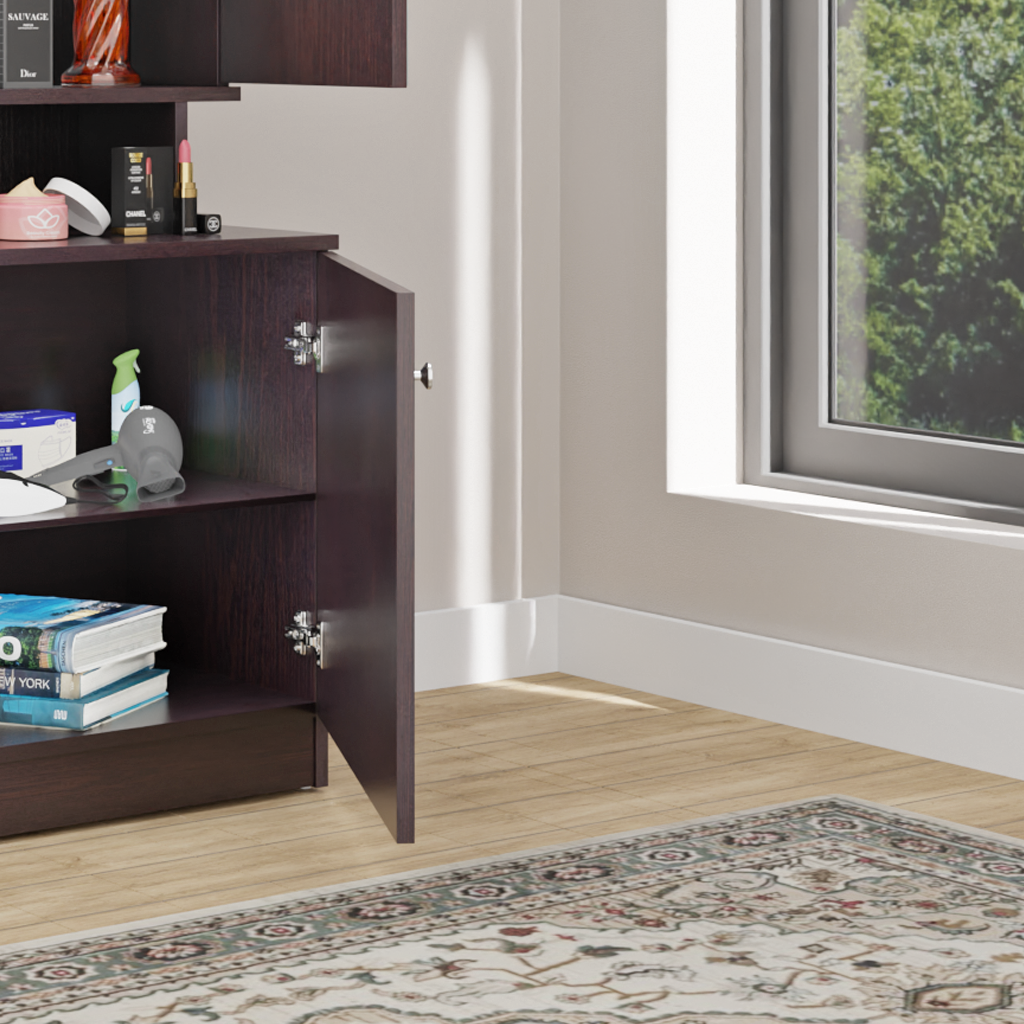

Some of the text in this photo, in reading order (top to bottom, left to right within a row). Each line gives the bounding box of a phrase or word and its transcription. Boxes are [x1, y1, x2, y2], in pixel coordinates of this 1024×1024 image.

[8, 12, 49, 21] SAUVAGE
[19, 68, 37, 78] Dior
[125, 210, 147, 218] CHANEL
[19, 677, 50, 690] YORK
